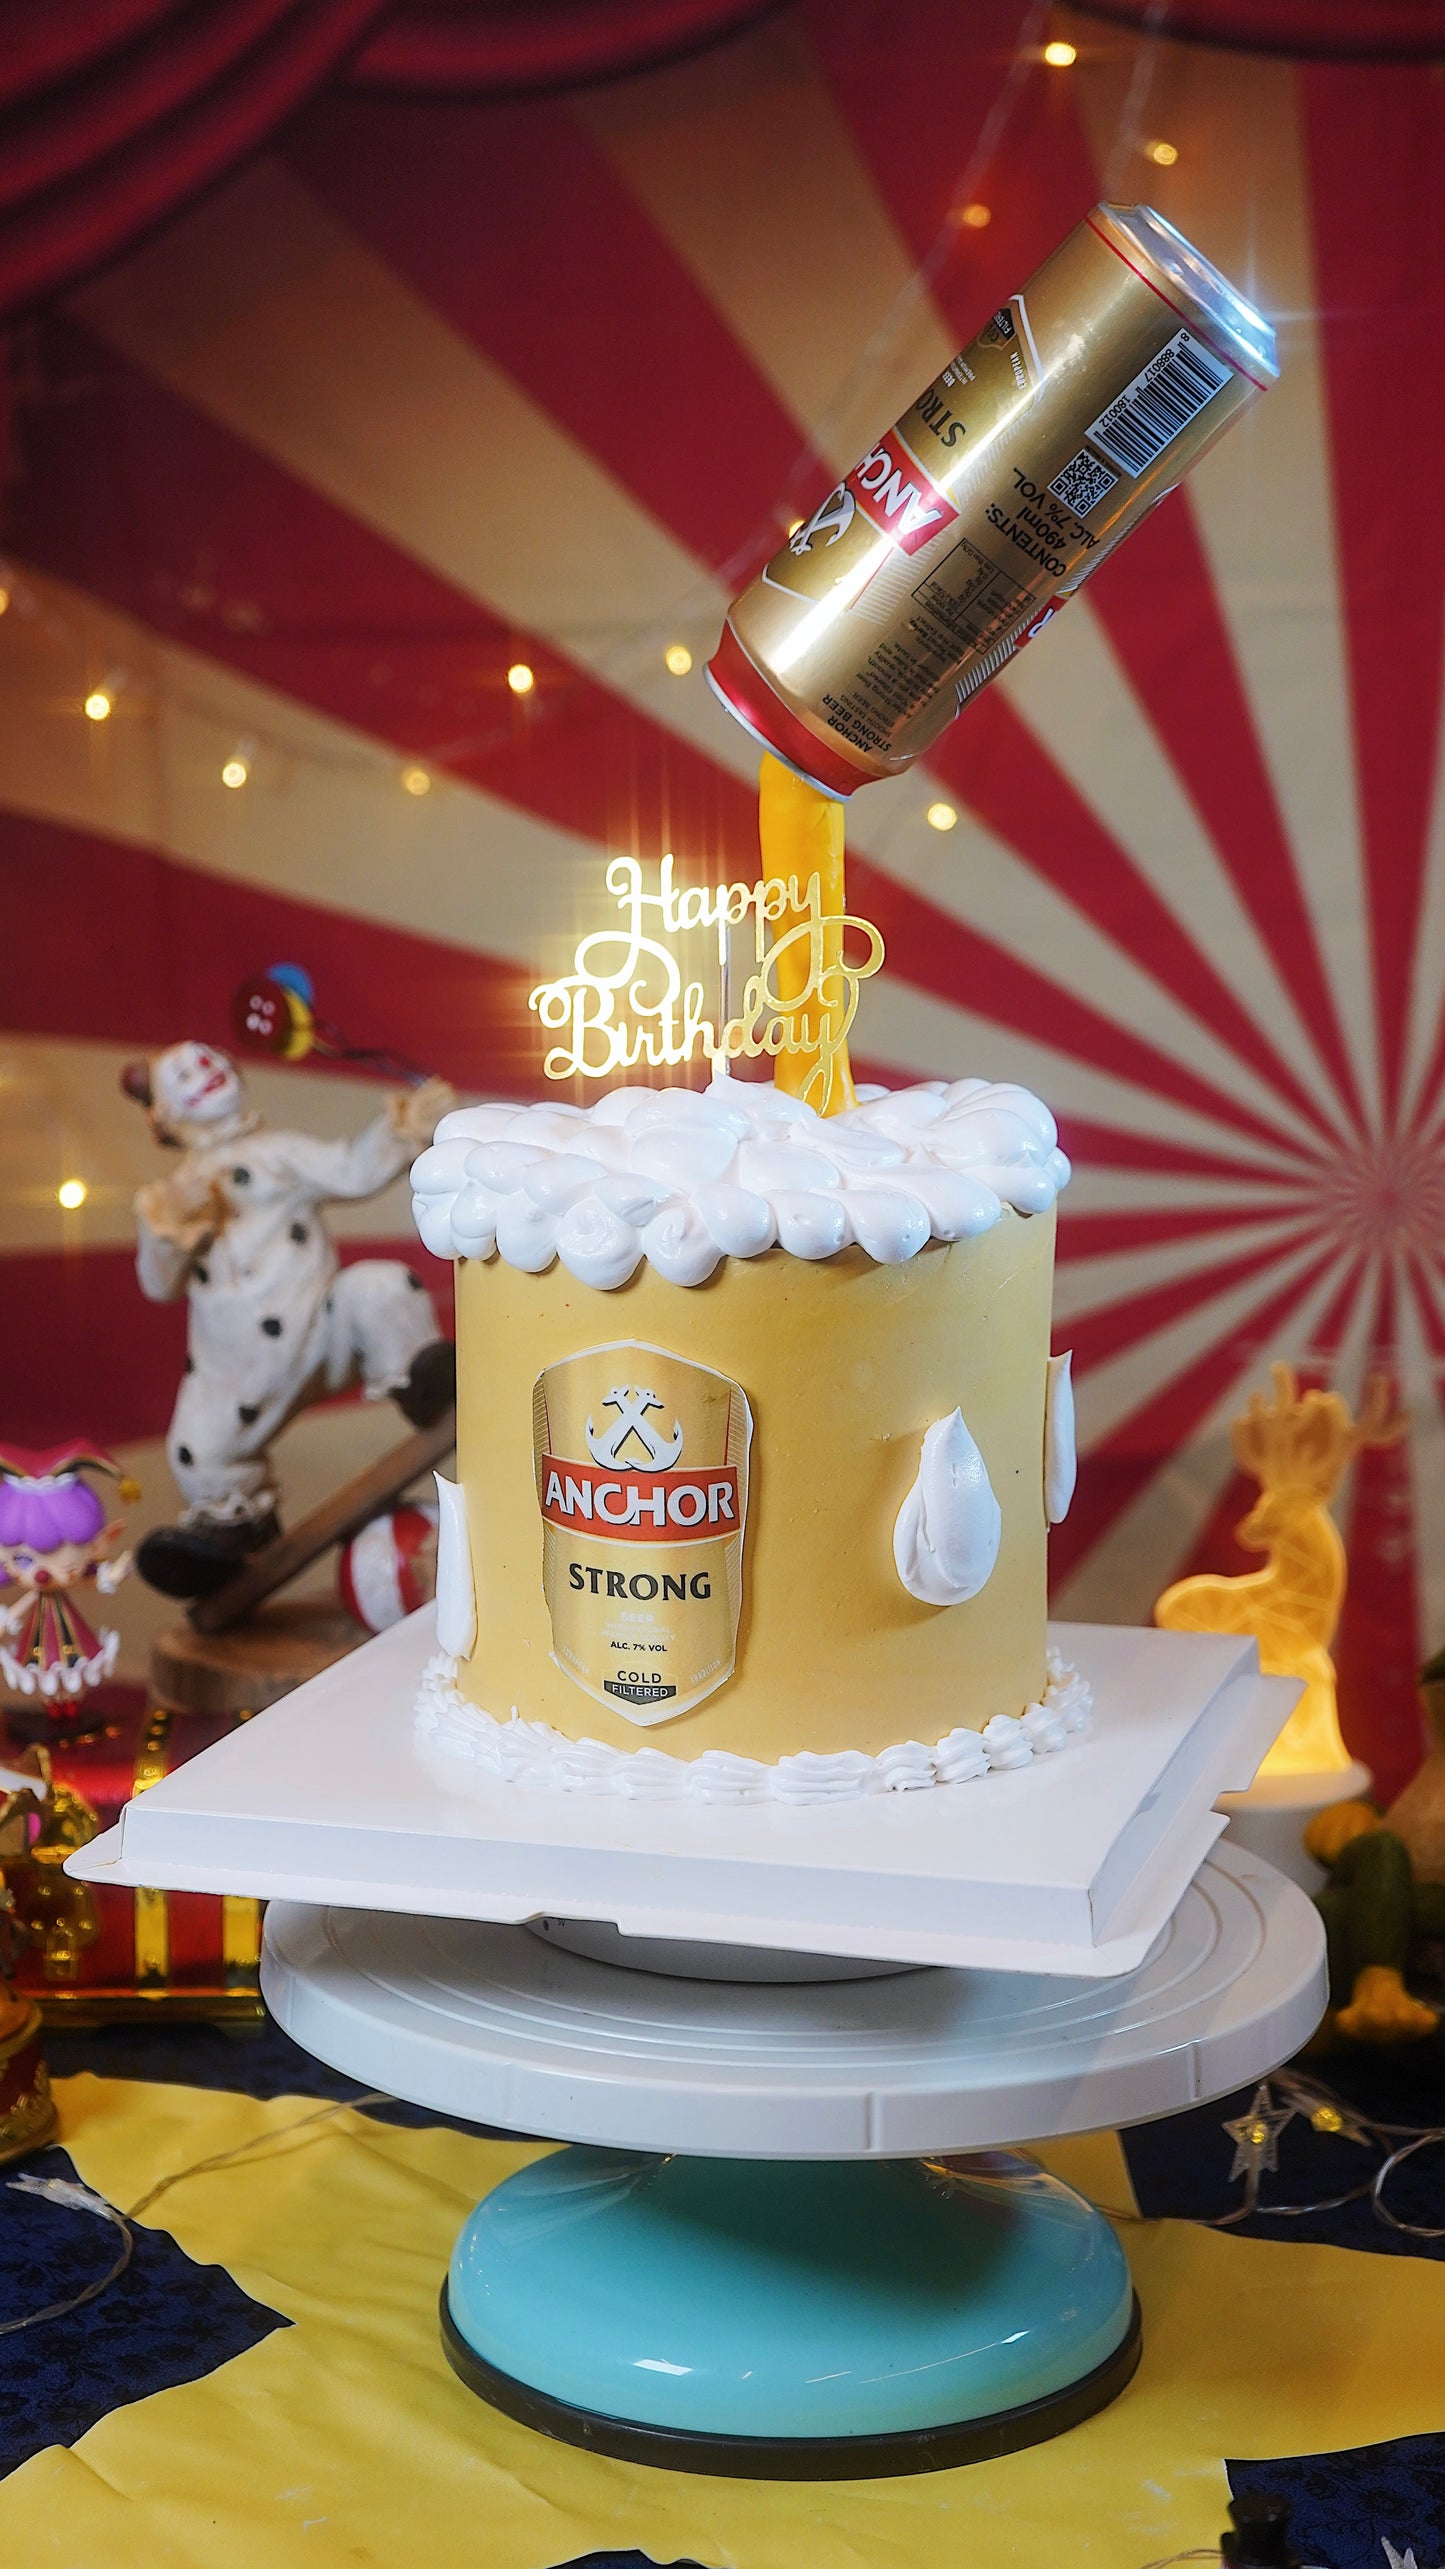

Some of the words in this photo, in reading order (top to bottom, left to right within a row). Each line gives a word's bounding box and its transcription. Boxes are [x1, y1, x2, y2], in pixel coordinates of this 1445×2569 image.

[1179, 331, 1191, 342] 8
[1010, 351, 1027, 389] EUROPEAN
[1143, 347, 1175, 381] 888017
[1098, 394, 1130, 427] 180012
[1004, 466, 1049, 510] VOL.
[1014, 504, 1068, 553] 490ml
[1042, 501, 1072, 530] 7%
[984, 502, 1065, 576] CONTENTS:
[1066, 521, 1100, 552] ALC.
[821, 693, 852, 722] BEER
[826, 715, 872, 754] ANCHOR
[851, 718, 892, 752] STRONG
[576, 853, 868, 1000] Happy
[528, 976, 860, 1108] Birthday
[544, 1471, 736, 1528] ANCHOR
[568, 1562, 712, 1602] STRONG
[610, 1641, 631, 1651] ALC.
[633, 1643, 646, 1652] 7%
[611, 1684, 669, 1698] FILTERED
[617, 1670, 662, 1684] COLD
